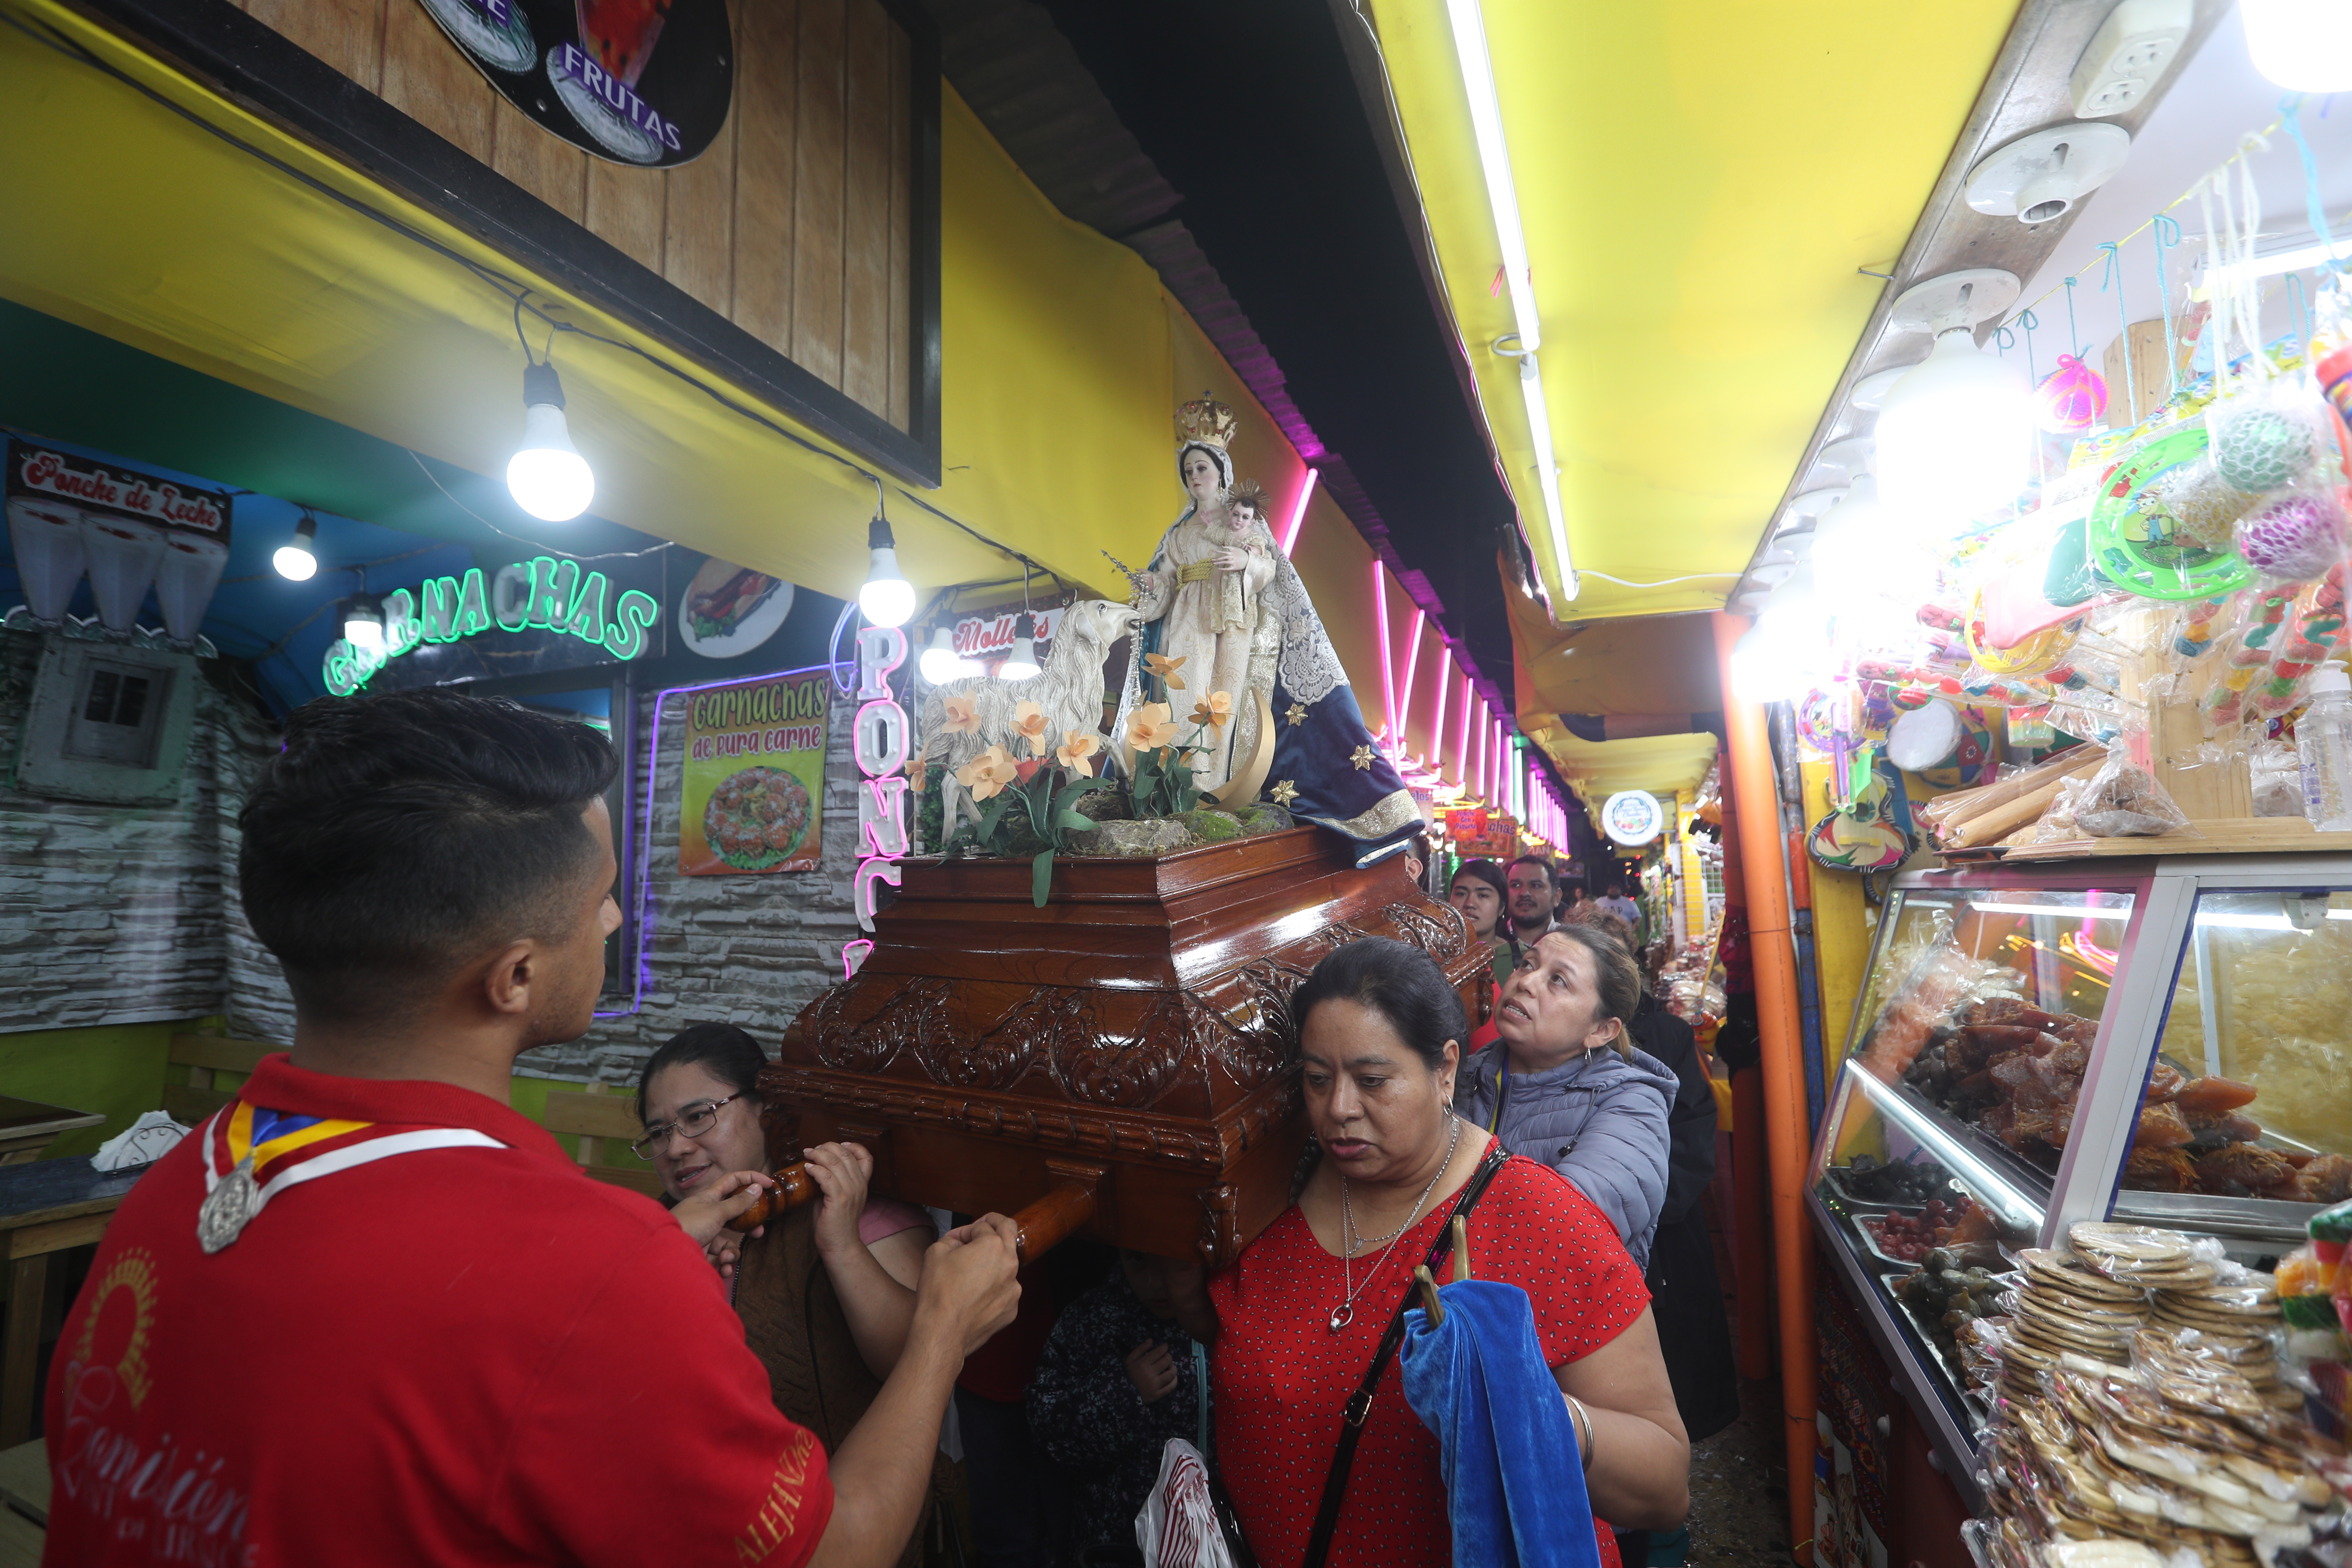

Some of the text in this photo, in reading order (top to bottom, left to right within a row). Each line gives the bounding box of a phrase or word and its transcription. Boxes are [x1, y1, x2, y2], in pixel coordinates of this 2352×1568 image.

[564, 42, 682, 151] FRUTAS
[26, 454, 219, 528] Ponche de Leche
[323, 556, 658, 697] GARNACHAS
[952, 614, 1049, 652] Molls
[692, 737, 712, 760] de
[843, 625, 910, 981] PONC
[1411, 790, 1430, 800] elos
[1488, 819, 1516, 835] chas
